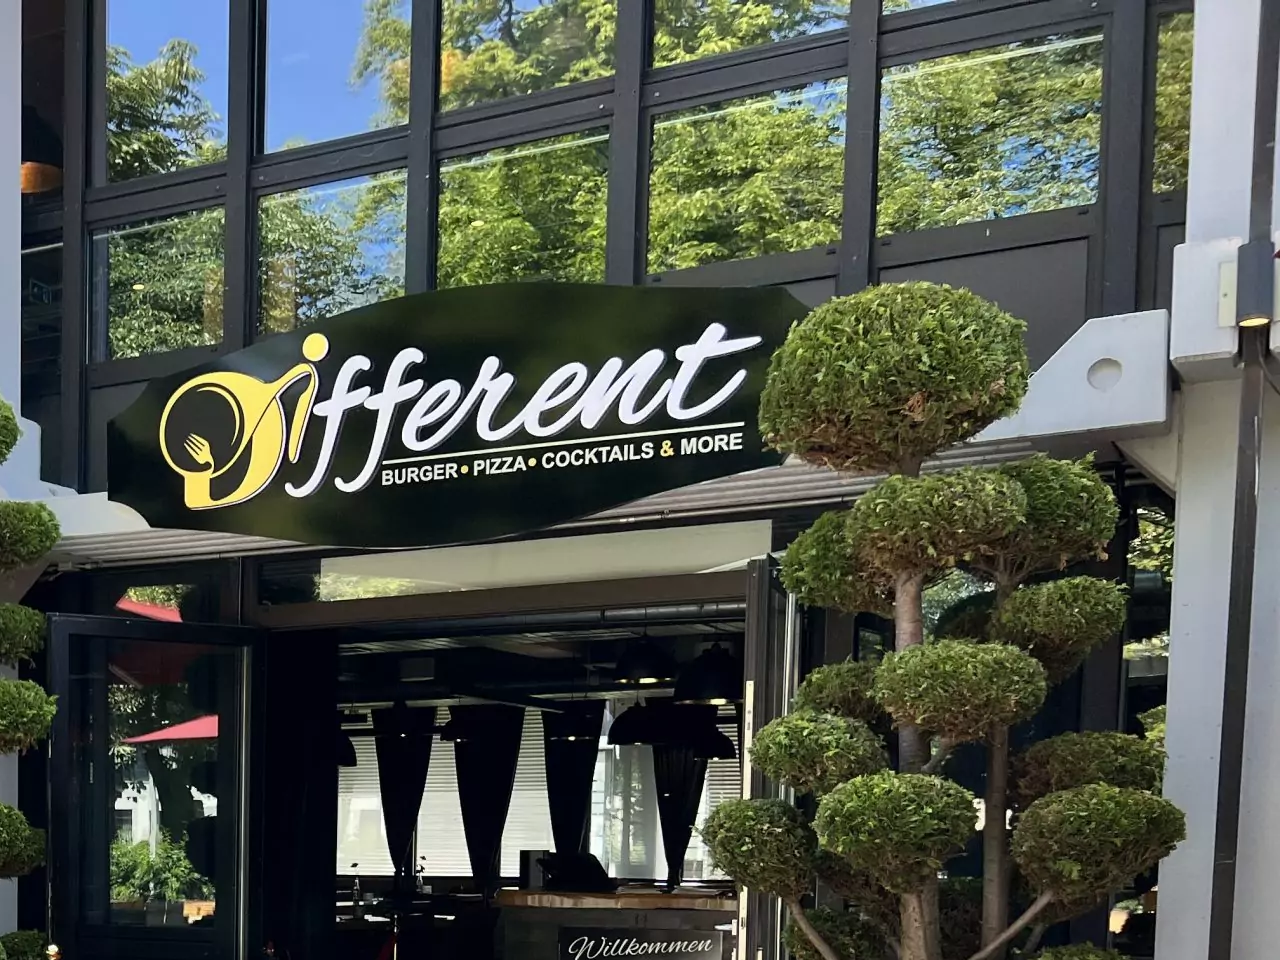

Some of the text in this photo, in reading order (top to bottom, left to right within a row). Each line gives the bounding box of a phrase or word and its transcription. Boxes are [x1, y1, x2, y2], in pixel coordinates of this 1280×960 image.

[158, 321, 764, 511] Different
[381, 432, 744, 487] BURGER PIZZA COCKTAILS & MORE
[568, 936, 713, 960] Willkommen
